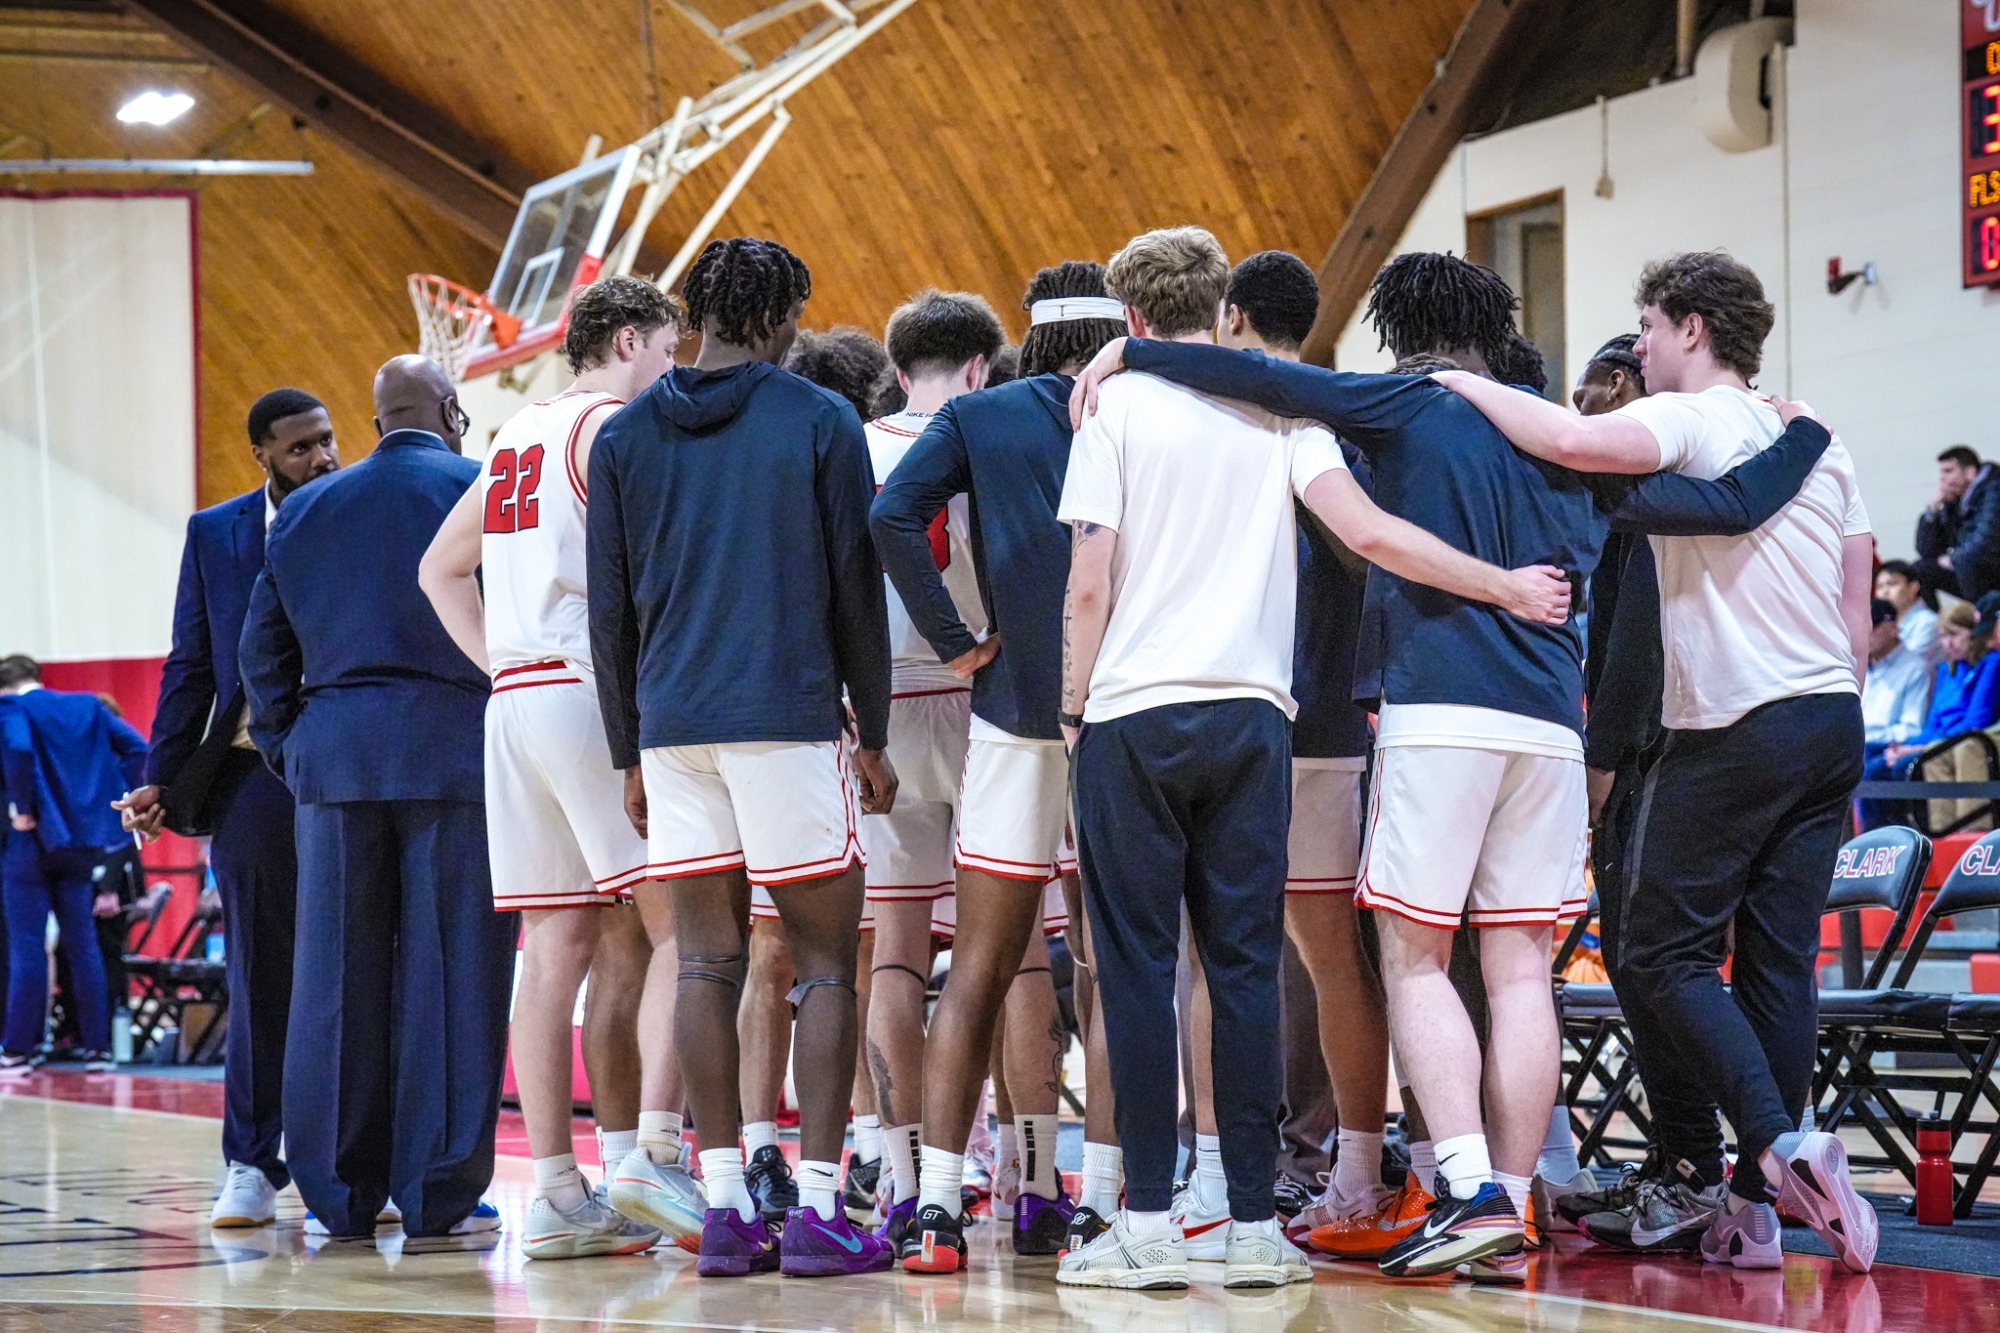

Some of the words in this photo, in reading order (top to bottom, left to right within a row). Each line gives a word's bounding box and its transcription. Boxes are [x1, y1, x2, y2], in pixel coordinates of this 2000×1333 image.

[483, 443, 545, 534] 22
[1833, 845, 1907, 879] CLARK
[922, 1209, 943, 1220] GT
